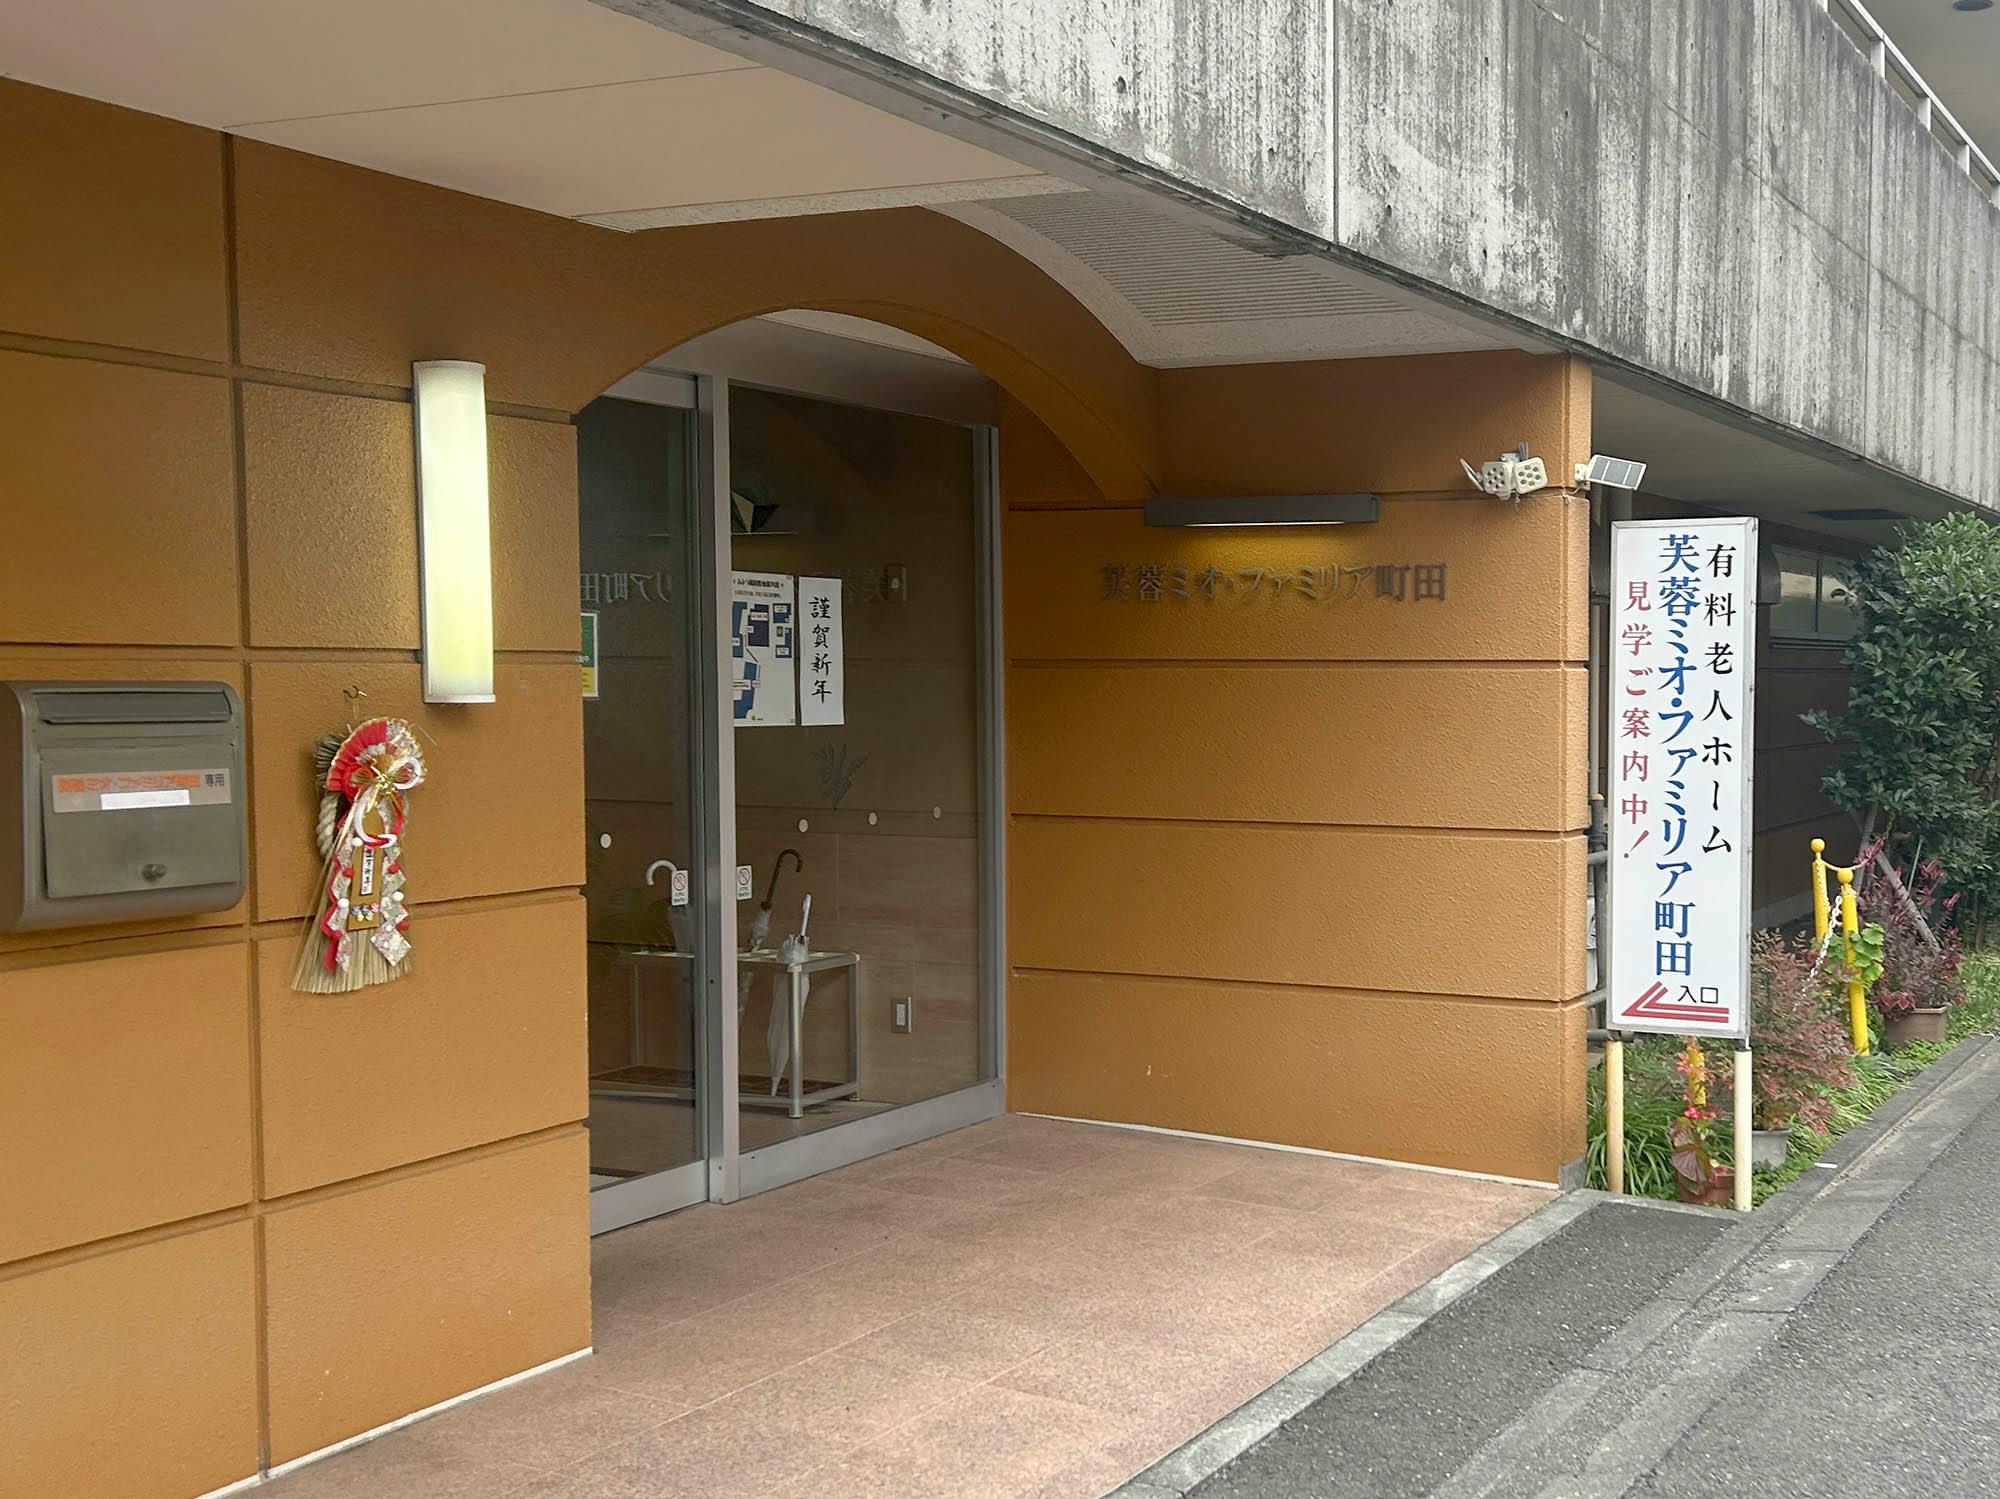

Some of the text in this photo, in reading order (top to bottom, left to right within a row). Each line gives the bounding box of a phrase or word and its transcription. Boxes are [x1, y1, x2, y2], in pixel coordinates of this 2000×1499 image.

[809, 596, 832, 703] 謹賀新年
[1100, 562, 1446, 602] 芙蓉ミオ・ファミリア町田
[1621, 580, 1653, 859] 見学ご案内中！
[1654, 534, 1700, 977] 芙蓉ミオ・ファミリア町田
[1702, 543, 1737, 854] 有料老人ホーム
[1677, 985, 1718, 1004] 入口
